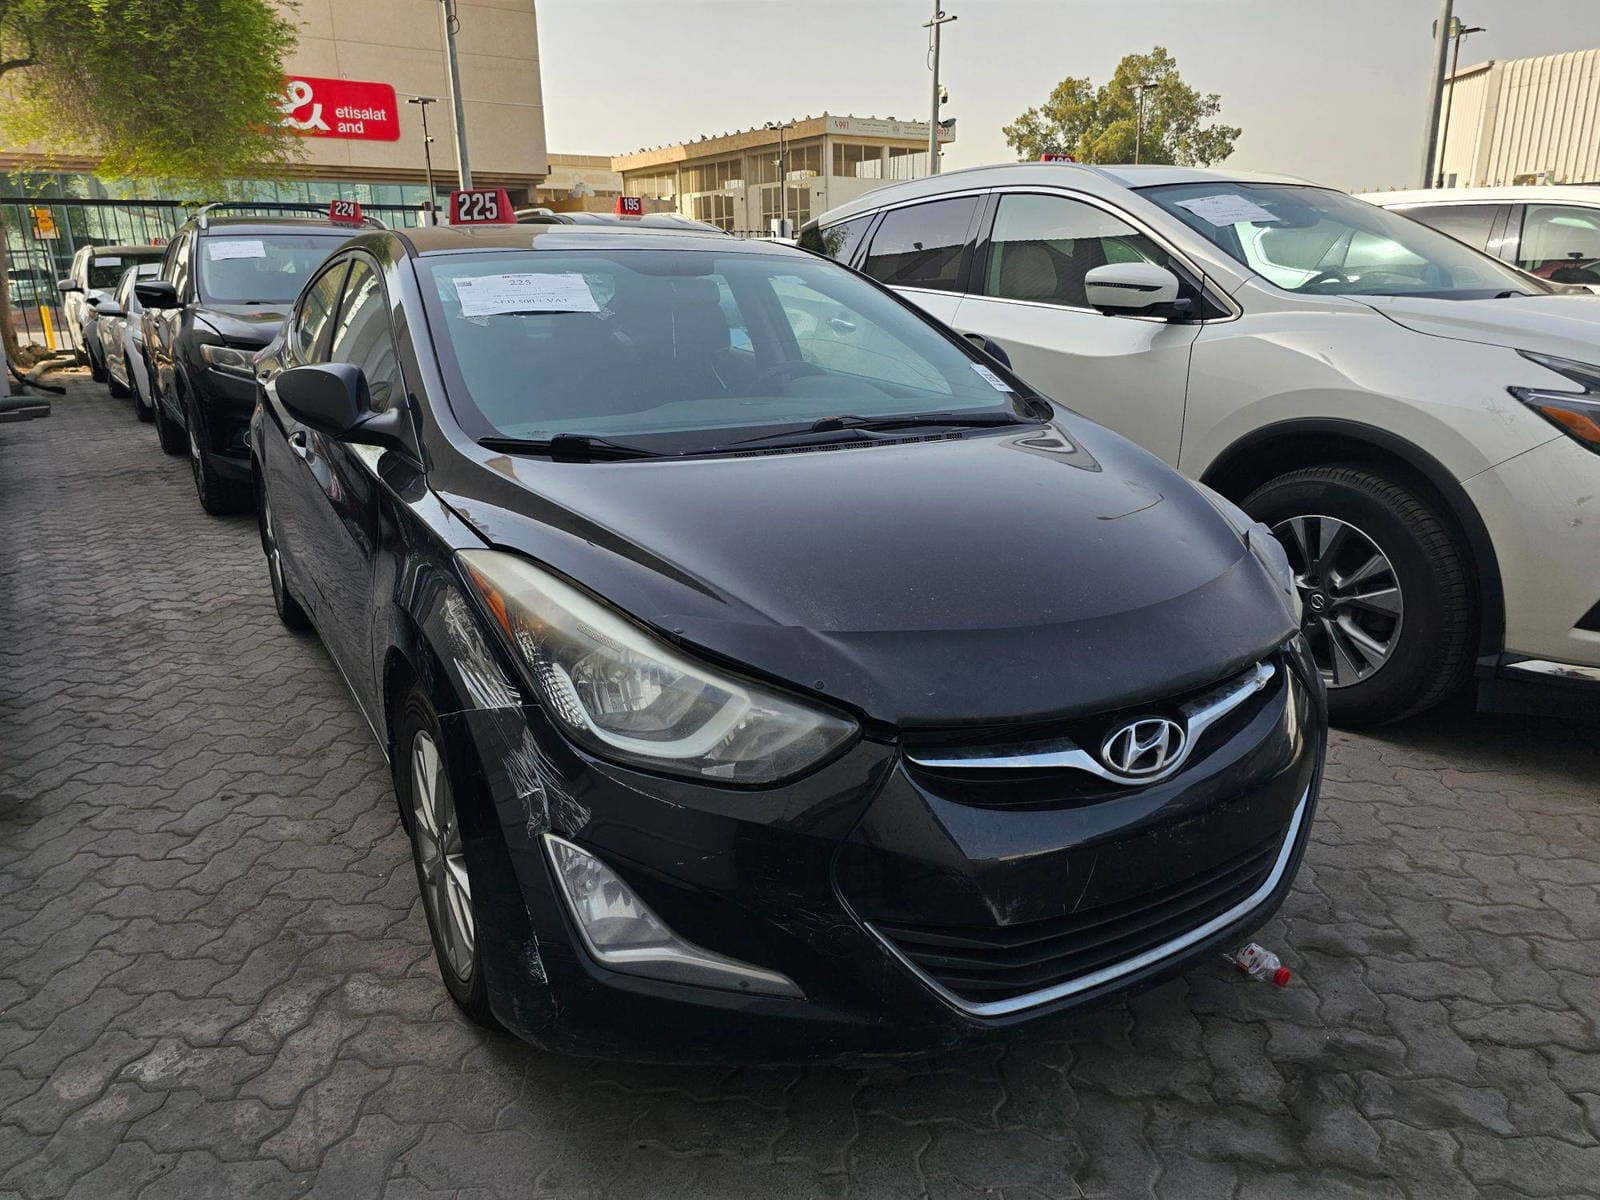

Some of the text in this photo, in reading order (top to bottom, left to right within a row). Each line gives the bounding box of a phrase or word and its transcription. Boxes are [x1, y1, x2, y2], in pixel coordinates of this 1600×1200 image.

[335, 105, 387, 121] etisalat
[337, 121, 365, 134] and
[335, 201, 355, 217] 224
[458, 192, 498, 221] 225
[623, 198, 640, 211] 195
